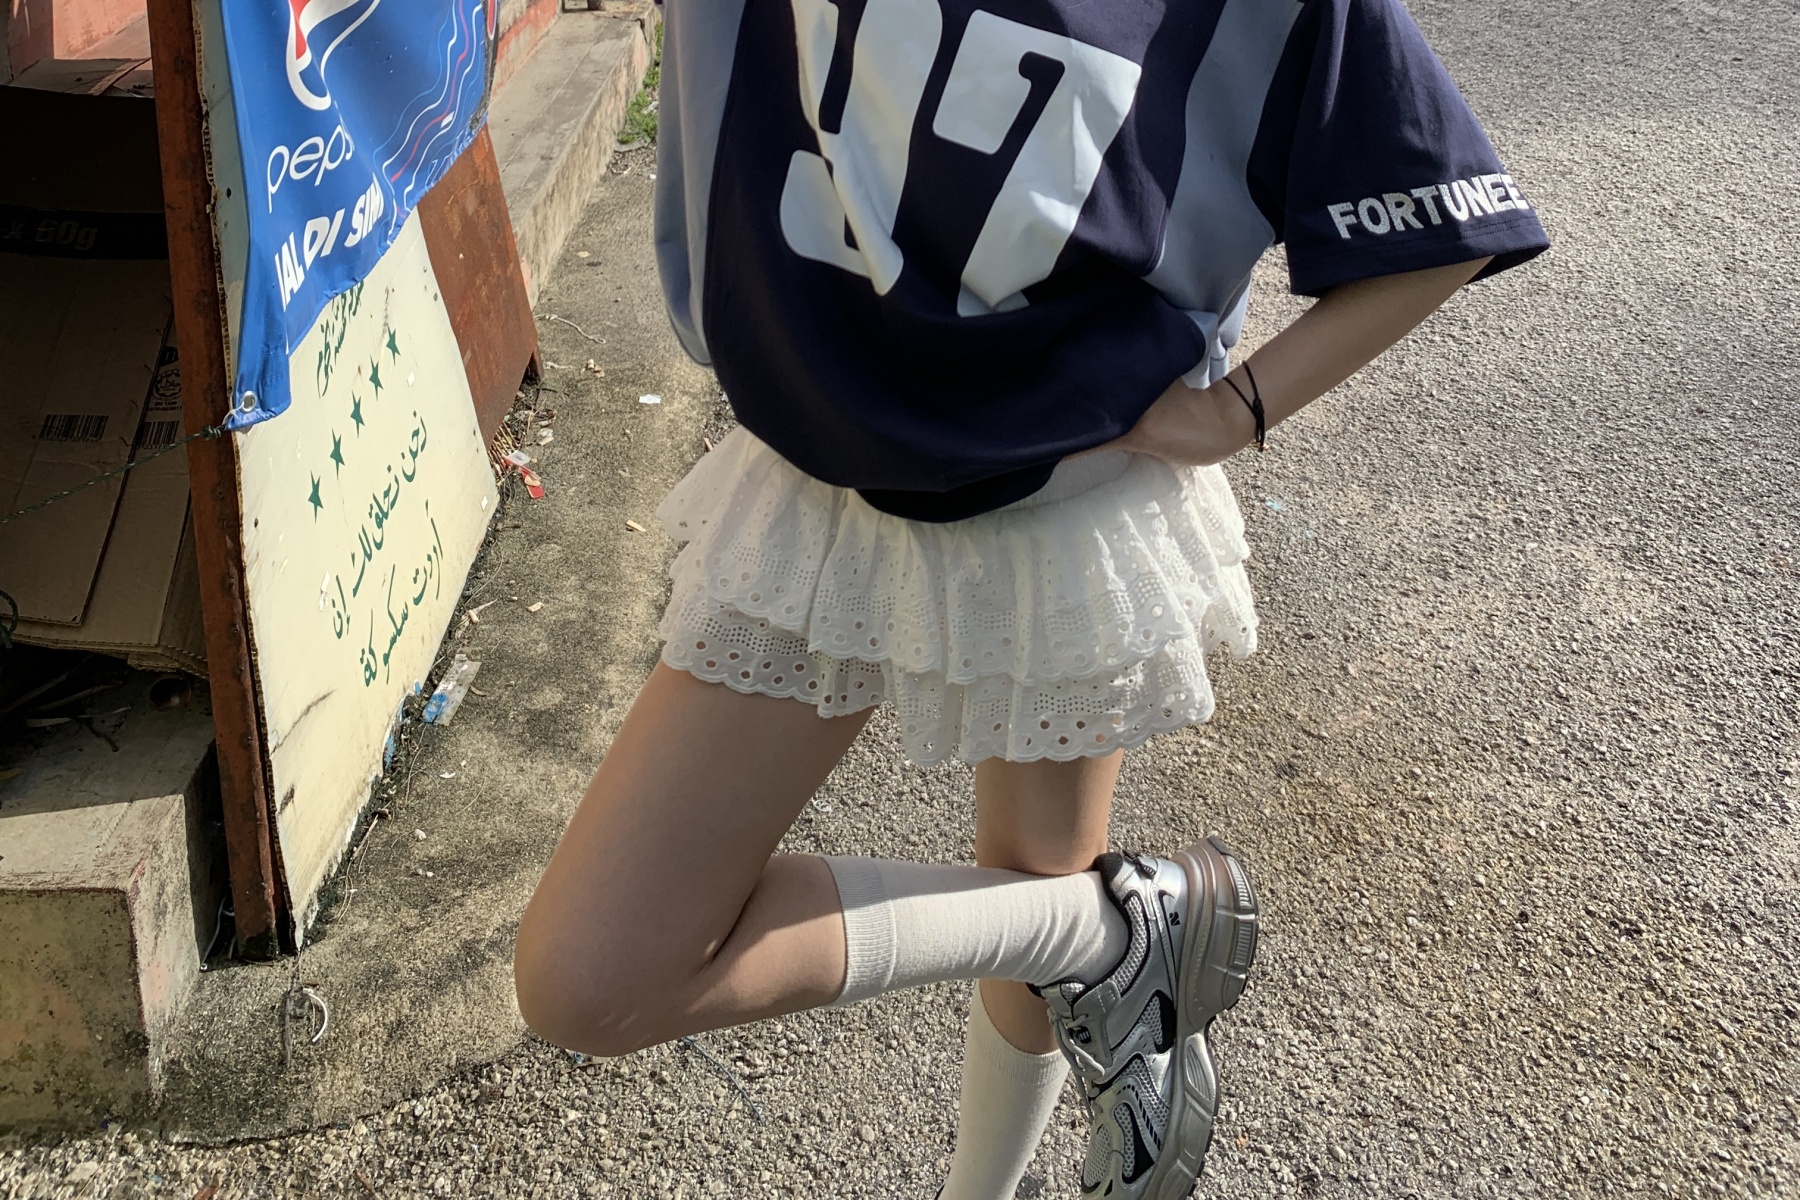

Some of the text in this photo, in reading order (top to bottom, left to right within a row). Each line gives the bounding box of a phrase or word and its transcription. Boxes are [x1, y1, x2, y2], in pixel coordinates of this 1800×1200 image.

[267, 112, 356, 214] peps
[34, 218, 98, 252] 60g
[1327, 173, 1530, 239] FORTUNEE
[303, 208, 346, 271] DI
[401, 409, 427, 483] نحن
